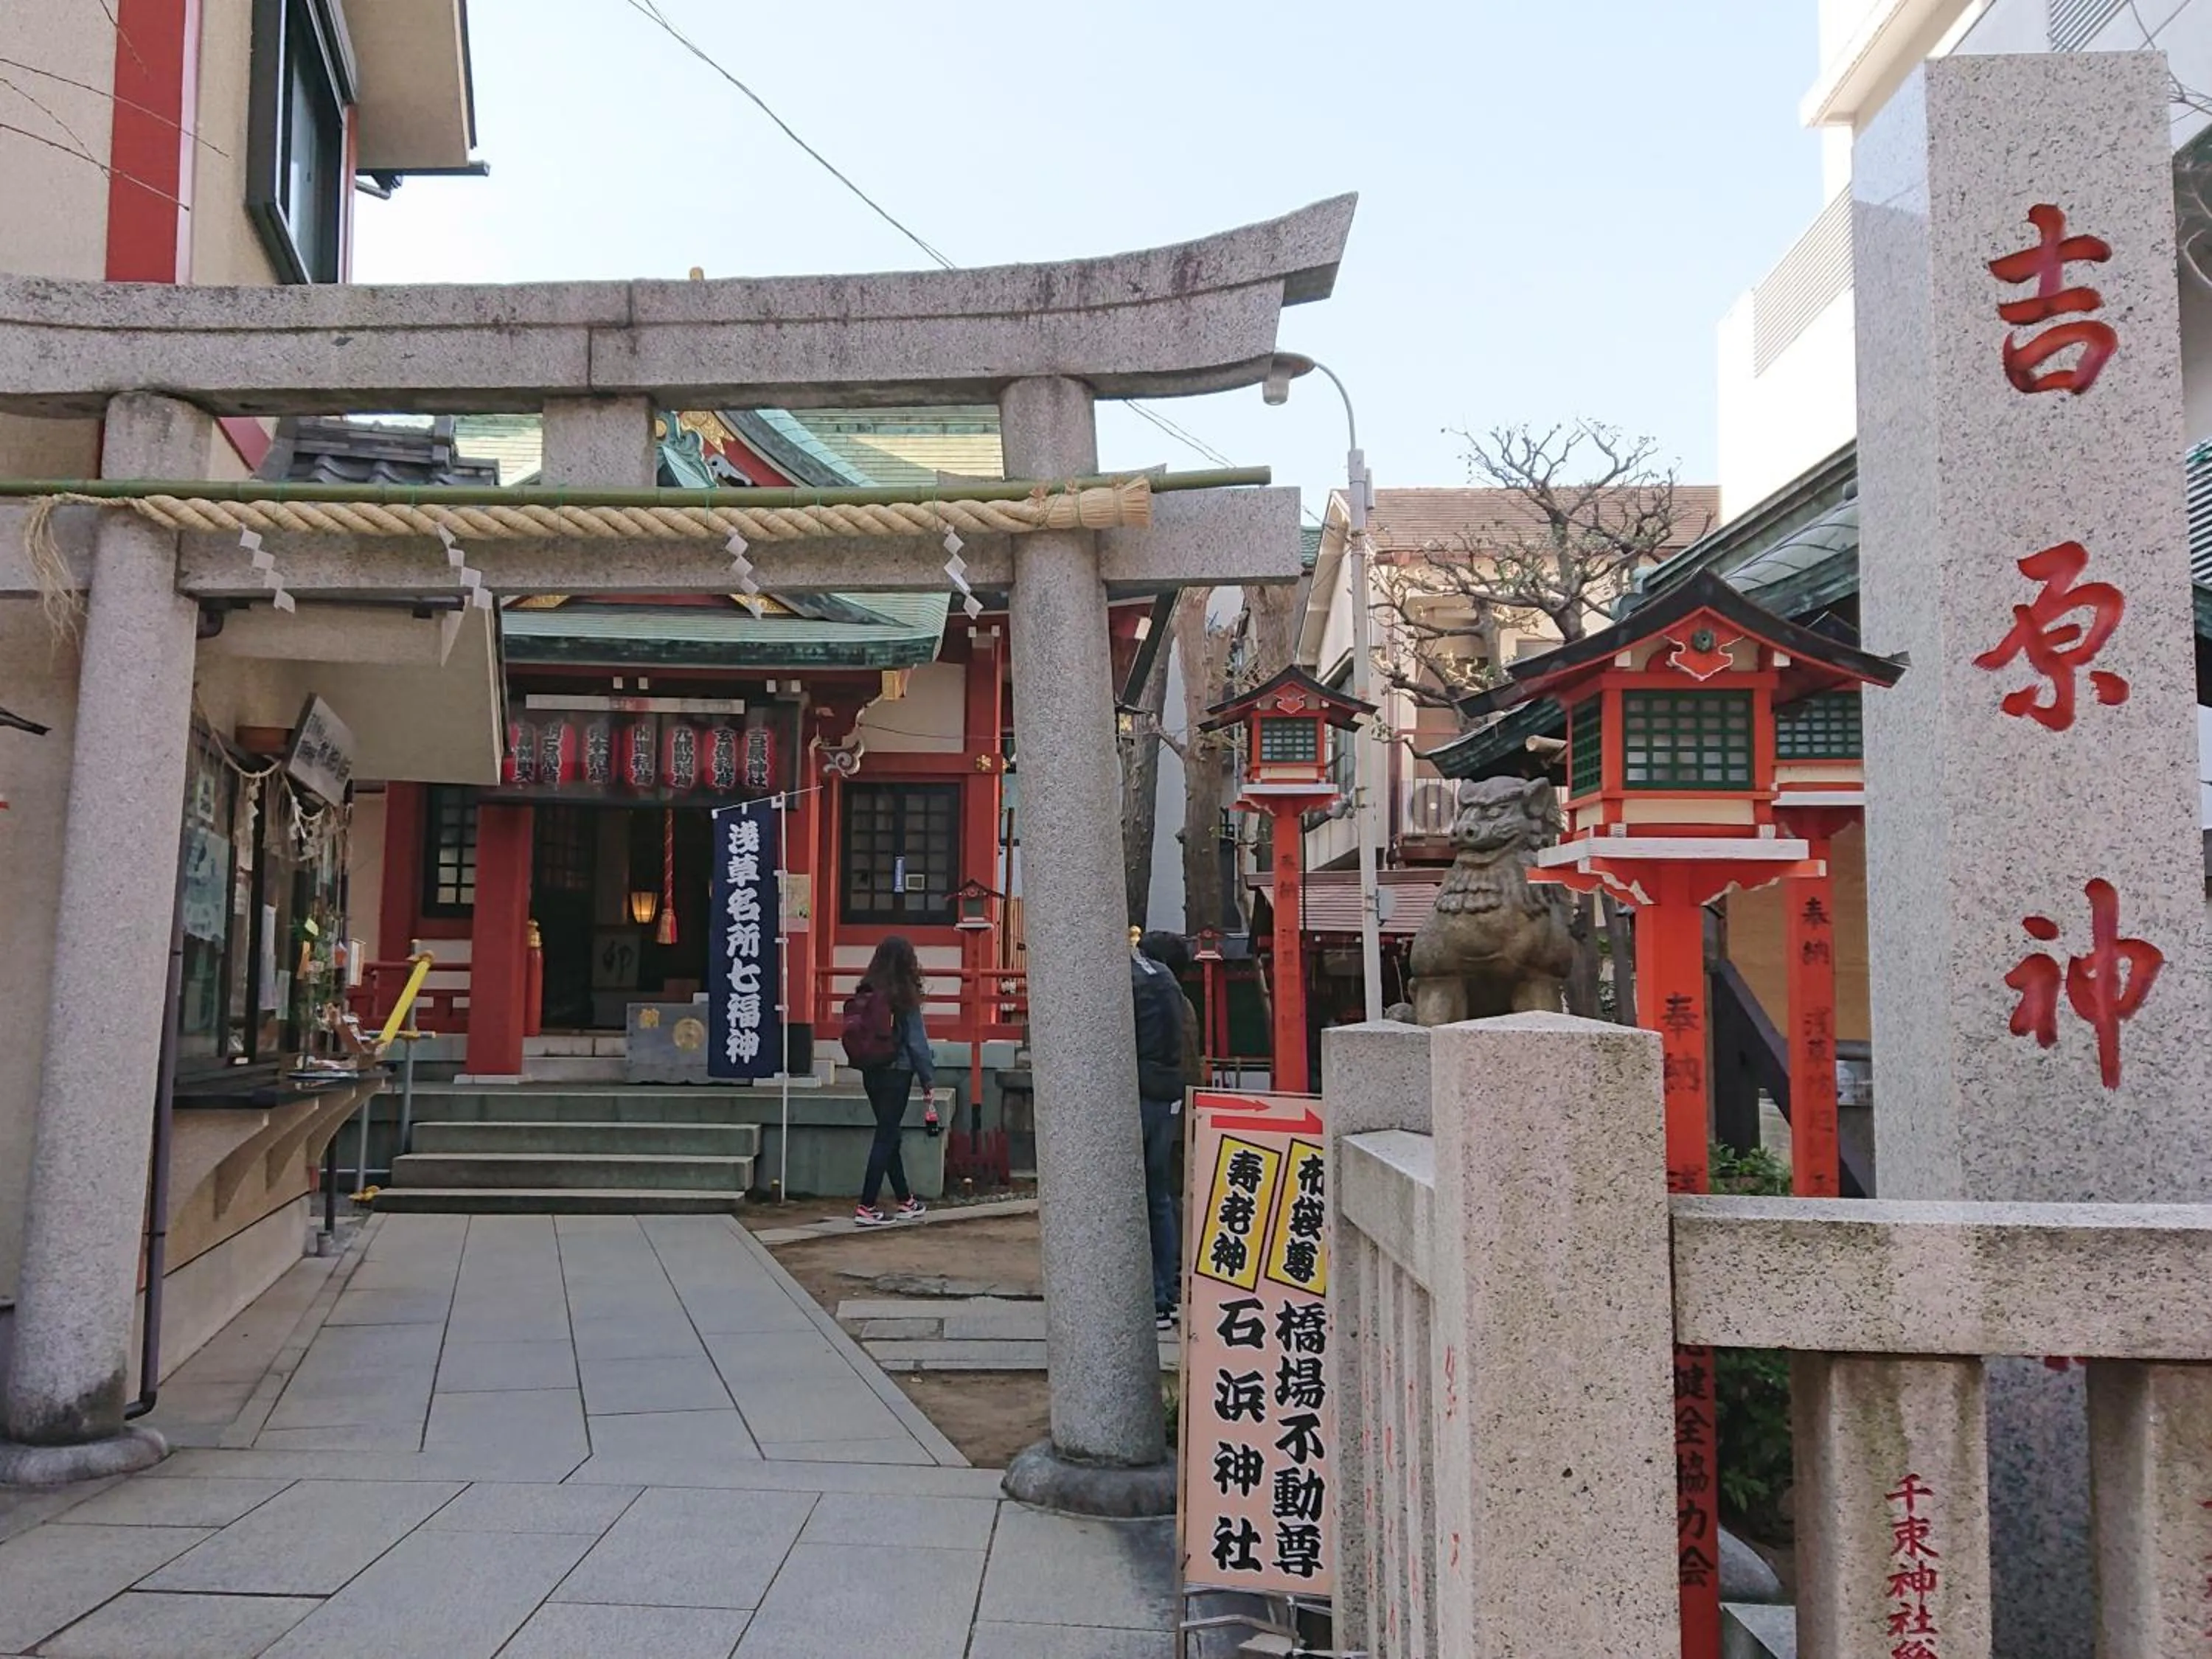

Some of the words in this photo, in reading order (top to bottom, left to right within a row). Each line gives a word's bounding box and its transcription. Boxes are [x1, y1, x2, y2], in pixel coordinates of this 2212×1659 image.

[726, 820, 761, 1064] 浅草名所七福神
[1801, 897, 1831, 966] 奉納
[1660, 990, 1700, 1095] 奉納
[1211, 1150, 1262, 1277] 寿老神
[1282, 1152, 1325, 1284] 布袋尊
[1211, 1298, 1267, 1573] 石浜神社
[1271, 1300, 1326, 1579] 橋場不動尊
